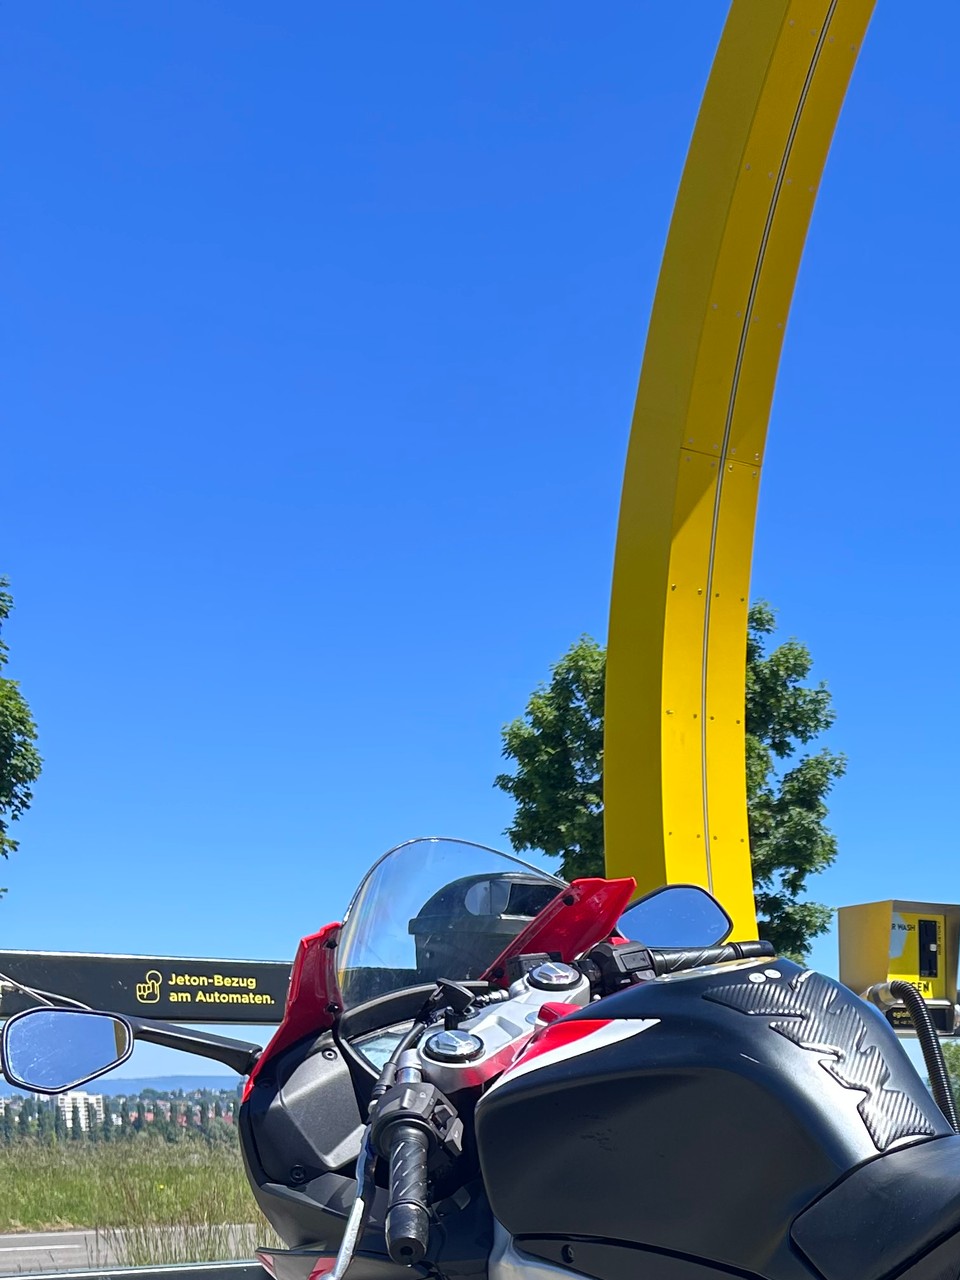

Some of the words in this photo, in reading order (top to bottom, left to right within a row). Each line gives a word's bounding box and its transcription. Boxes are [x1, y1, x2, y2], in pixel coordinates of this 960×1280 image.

[897, 923, 916, 931] WASH
[168, 973, 256, 989] Jeton-Bezug
[169, 992, 191, 1002] am
[195, 991, 275, 1004] Automaten.
